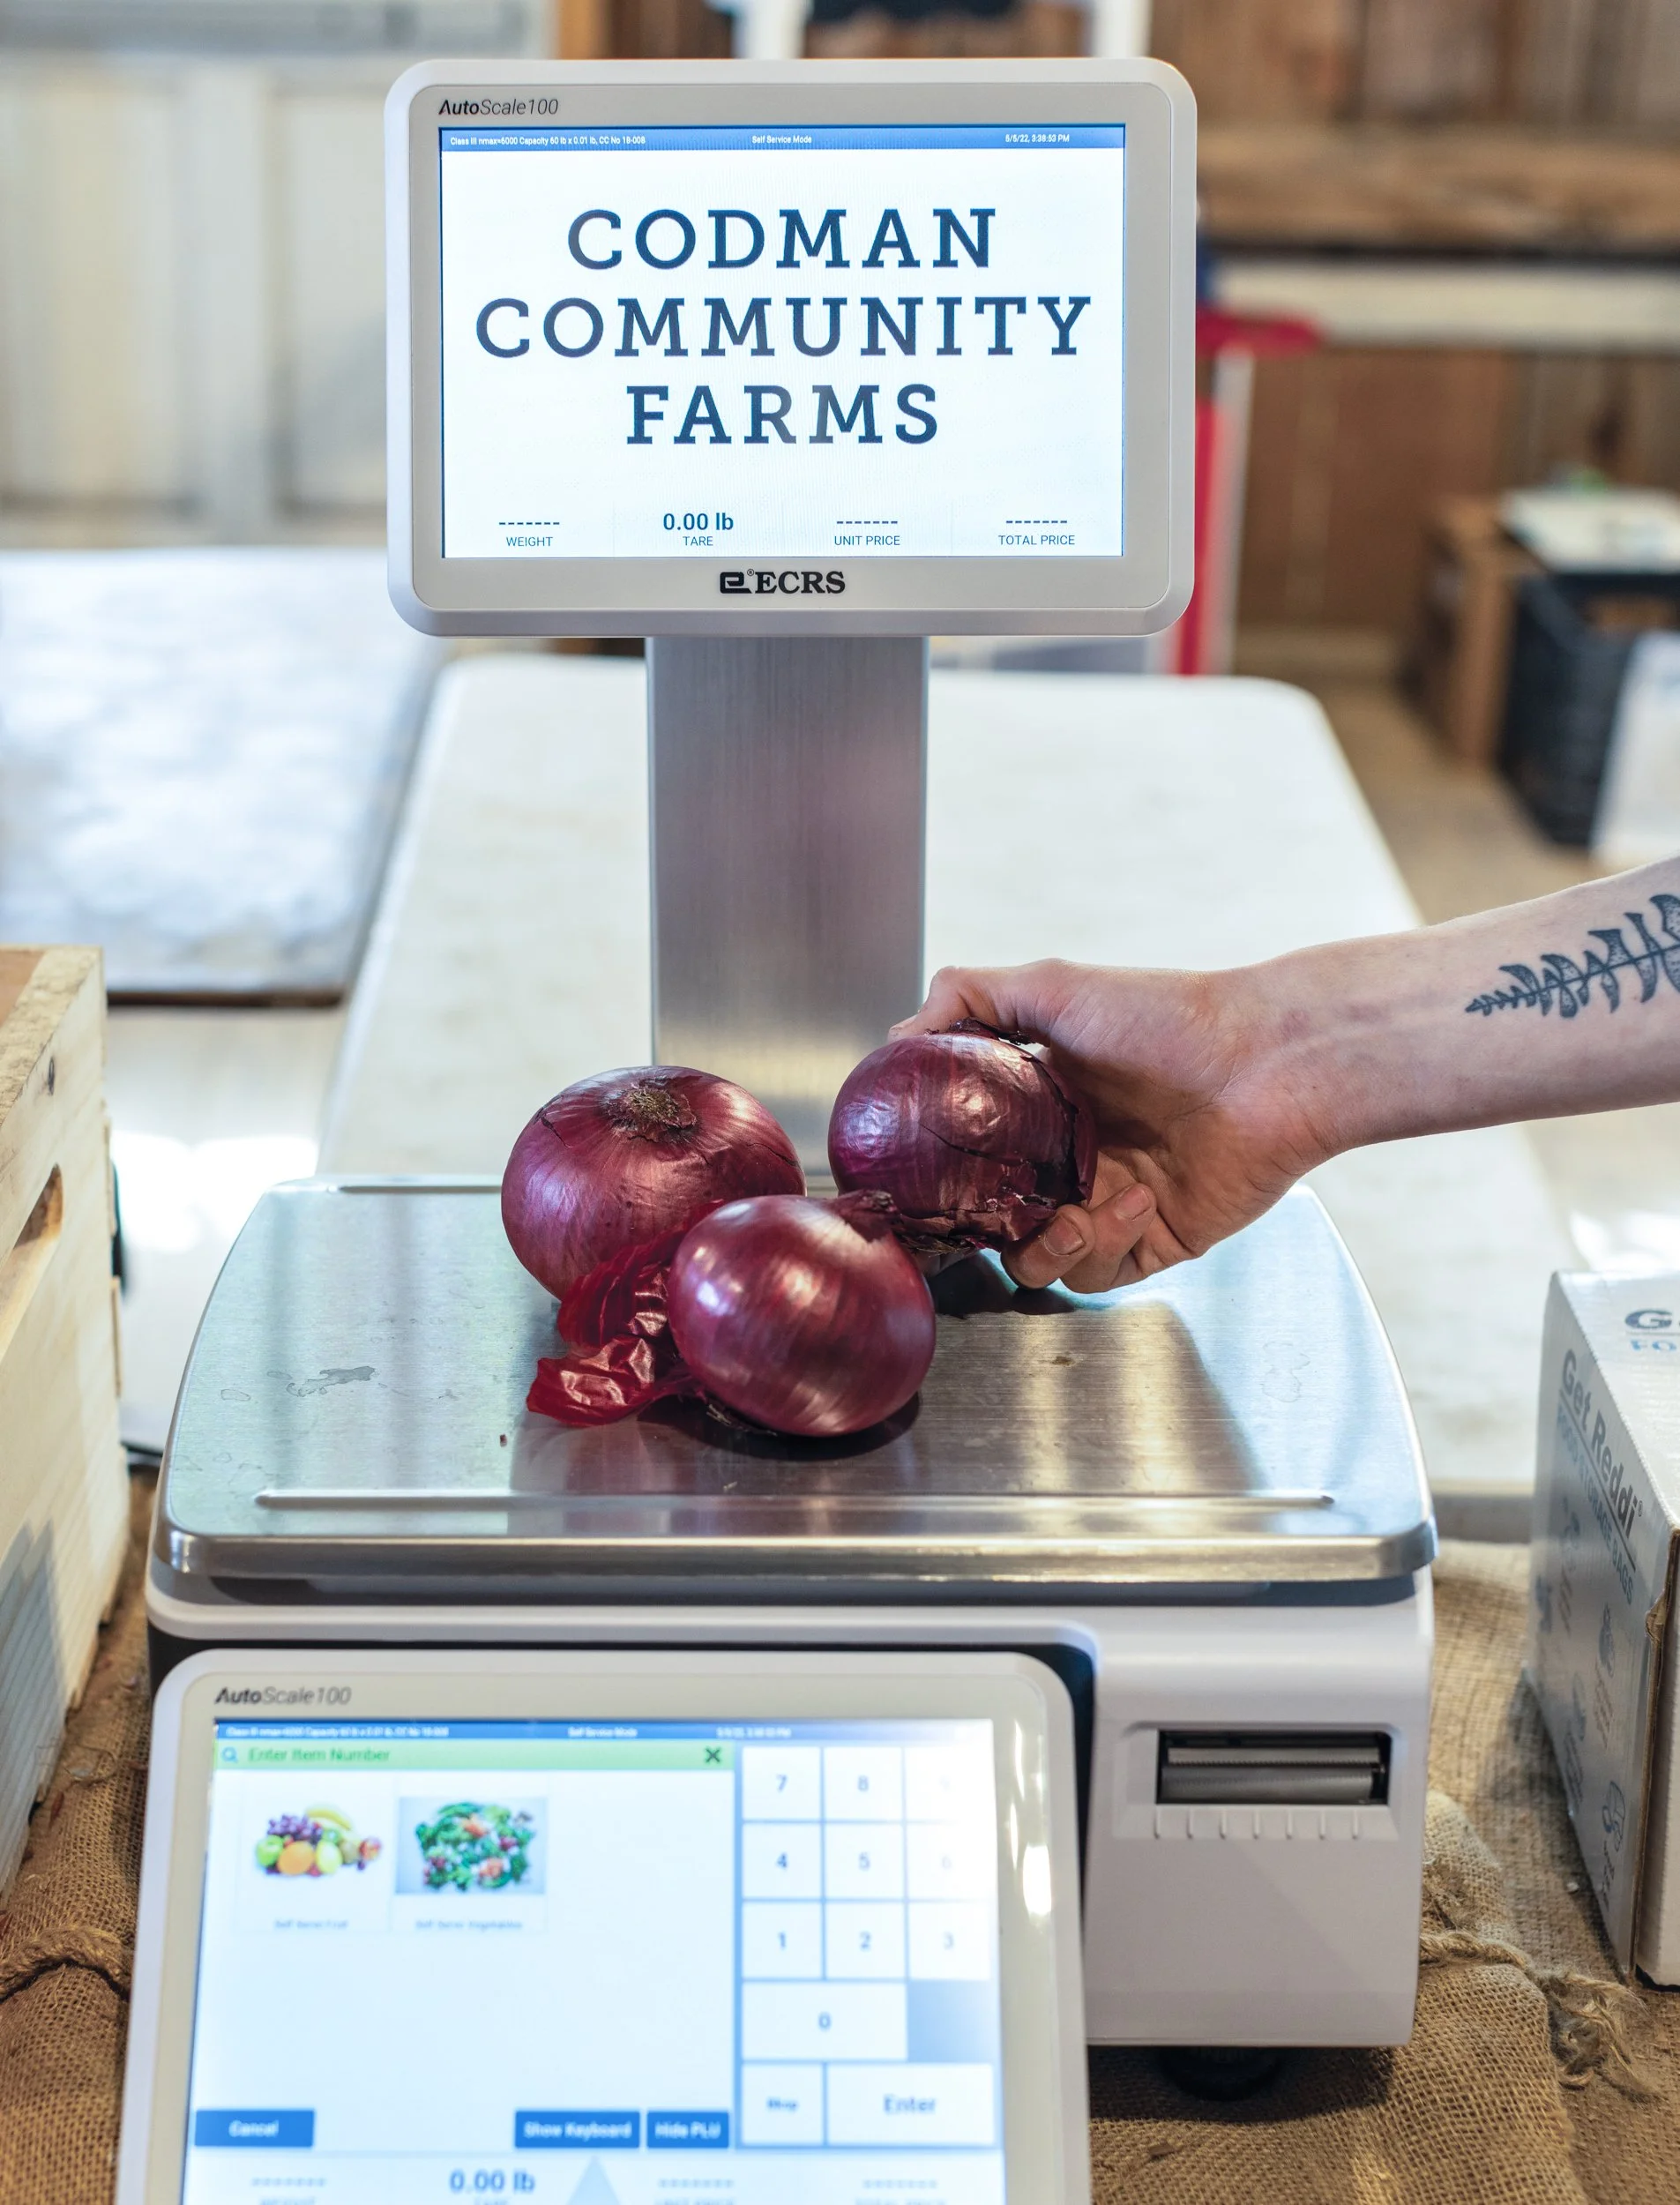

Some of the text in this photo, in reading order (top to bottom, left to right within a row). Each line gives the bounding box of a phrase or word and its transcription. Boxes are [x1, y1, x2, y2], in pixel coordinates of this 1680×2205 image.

[438, 98, 559, 116] AutoScale100
[450, 137, 469, 146] Class
[478, 137, 518, 146] nmax=6000
[519, 137, 549, 146] Capacity
[549, 136, 559, 145] 60
[560, 136, 567, 145] lb
[573, 136, 587, 145] 0.01
[599, 136, 609, 145] CC
[610, 136, 621, 145] No
[751, 135, 812, 144] Self Service Mode
[568, 208, 996, 270] CODMAN
[475, 295, 1092, 358] COMMUNITY
[626, 383, 938, 445] FARMS
[663, 512, 734, 531] 0.00 lb
[505, 536, 554, 547] WEIGHT
[683, 535, 713, 547] TARE
[833, 534, 900, 546] UNIT PRICE
[997, 534, 1075, 546] TOTAL PRICE
[755, 571, 846, 594] ECRS
[1562, 1348, 1592, 1431] Get
[1577, 1452, 1613, 1552] STORAGE
[1611, 1538, 1633, 1605] BAGS
[214, 1686, 353, 1706] AutoScale100
[248, 1747, 391, 1762] Enter Item Number
[776, 1774, 788, 1792] 7
[857, 1775, 870, 1792] 8
[775, 1851, 788, 1870] 4
[858, 1852, 870, 1871] 5
[778, 1931, 787, 1950] 1
[859, 1931, 871, 1951] 2
[818, 2012, 832, 2031] 0
[884, 2095, 936, 2114] Enter
[228, 2119, 279, 2138] Cancel
[523, 2120, 632, 2141] Show Keyboard
[654, 2120, 690, 2139] Hide
[449, 2168, 536, 2194] 0.00 lb
